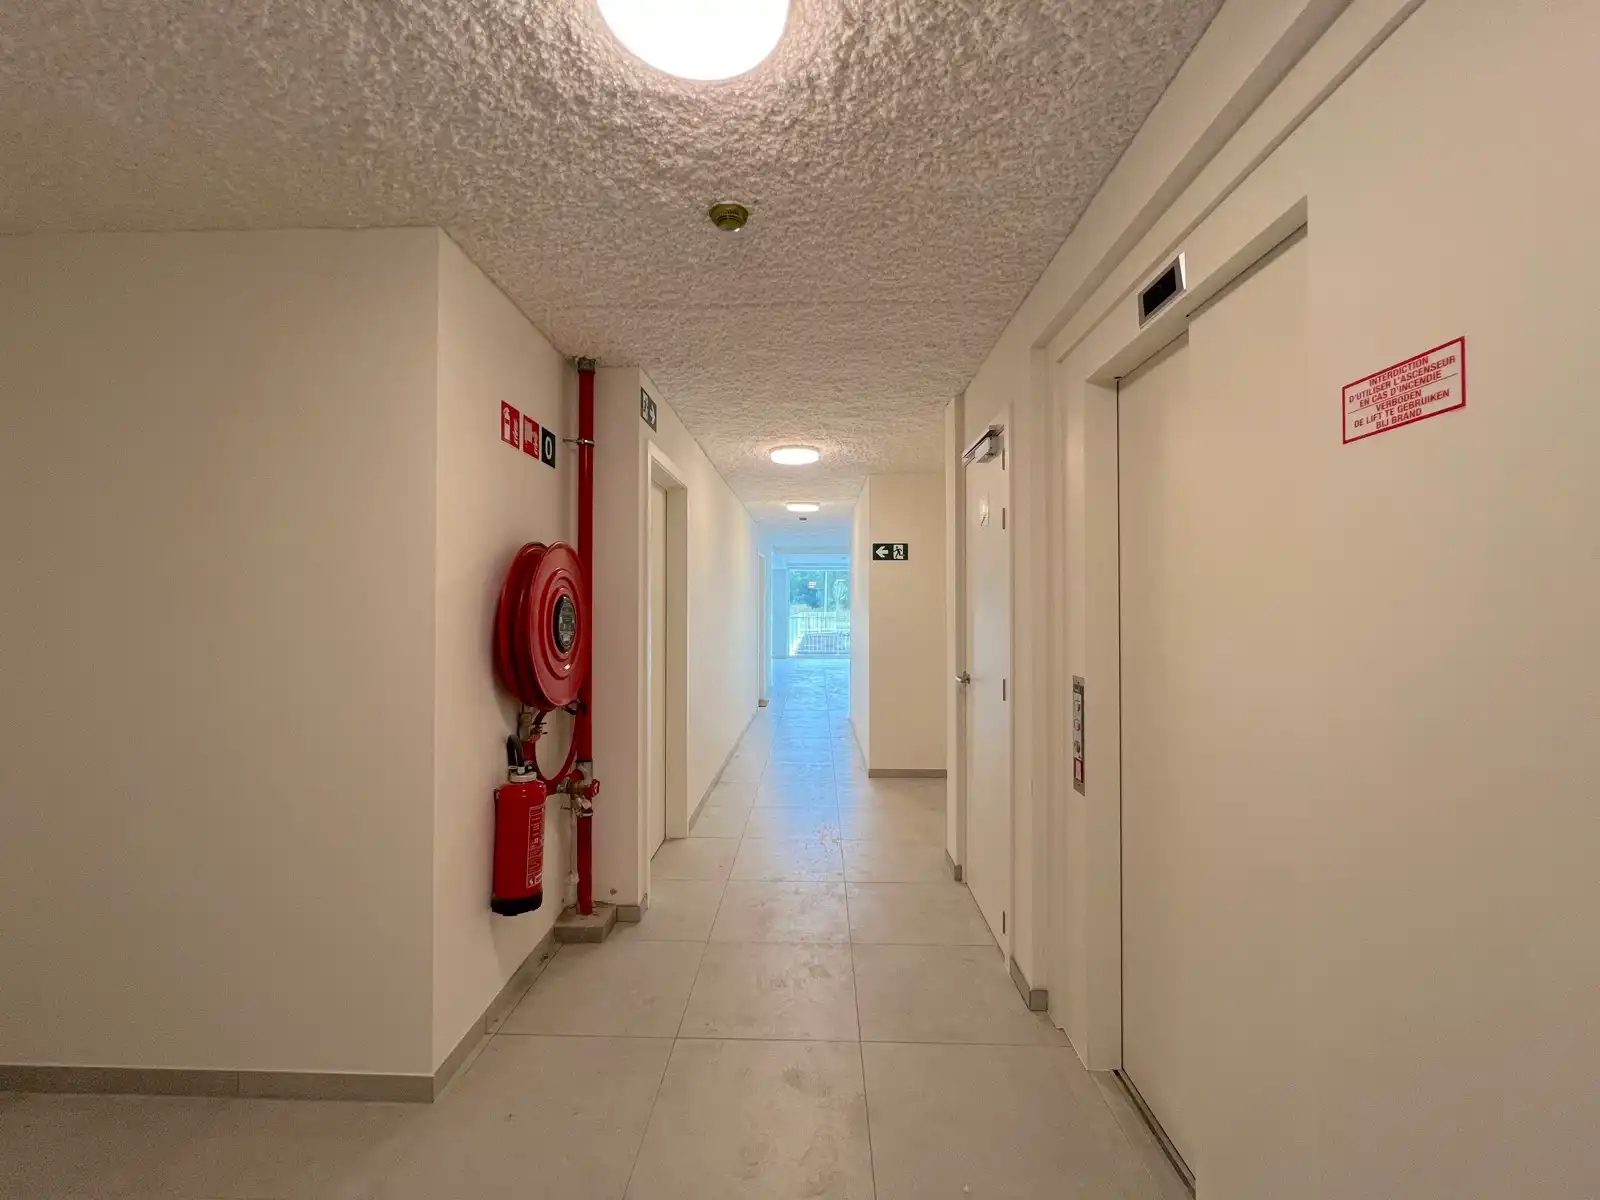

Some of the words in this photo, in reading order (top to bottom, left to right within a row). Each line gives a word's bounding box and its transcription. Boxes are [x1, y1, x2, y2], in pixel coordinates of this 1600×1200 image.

[1349, 380, 1391, 403] D'UTILISER
[1393, 355, 1456, 385] L'ASCENSEUR
[1369, 356, 1429, 386] INTERDICTION
[1359, 396, 1370, 407] EN
[1372, 390, 1388, 403] CAS
[1390, 370, 1442, 395] D'INCENDIE
[1376, 389, 1422, 411] VERBODEN
[1354, 418, 1364, 428] DE
[1366, 411, 1382, 424] LIFT
[1385, 407, 1395, 418] TE
[1397, 389, 1450, 412] GEBRUIKEN
[1376, 418, 1389, 429] BIJ
[1391, 408, 1422, 424] BRAND
